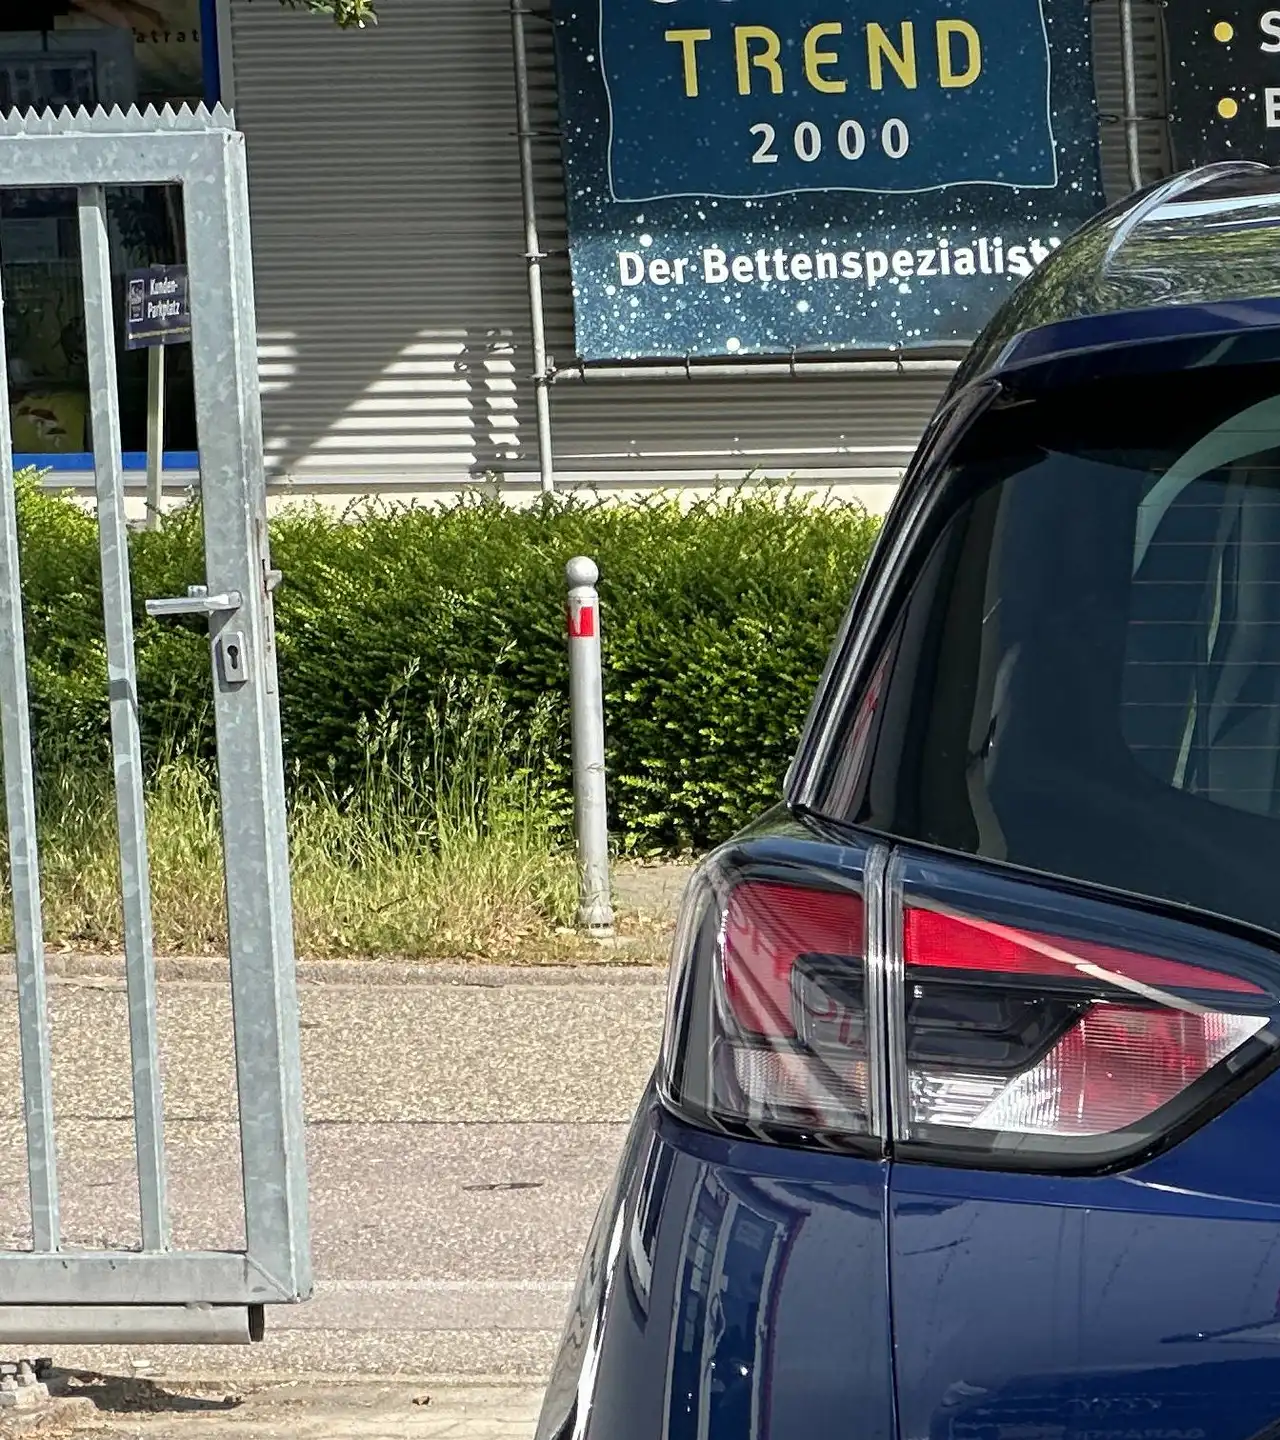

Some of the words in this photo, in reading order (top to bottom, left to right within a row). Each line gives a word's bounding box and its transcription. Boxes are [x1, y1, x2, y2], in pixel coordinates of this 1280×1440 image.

[665, 20, 982, 97] TREND
[750, 118, 909, 163] 2000
[619, 251, 689, 286] Der
